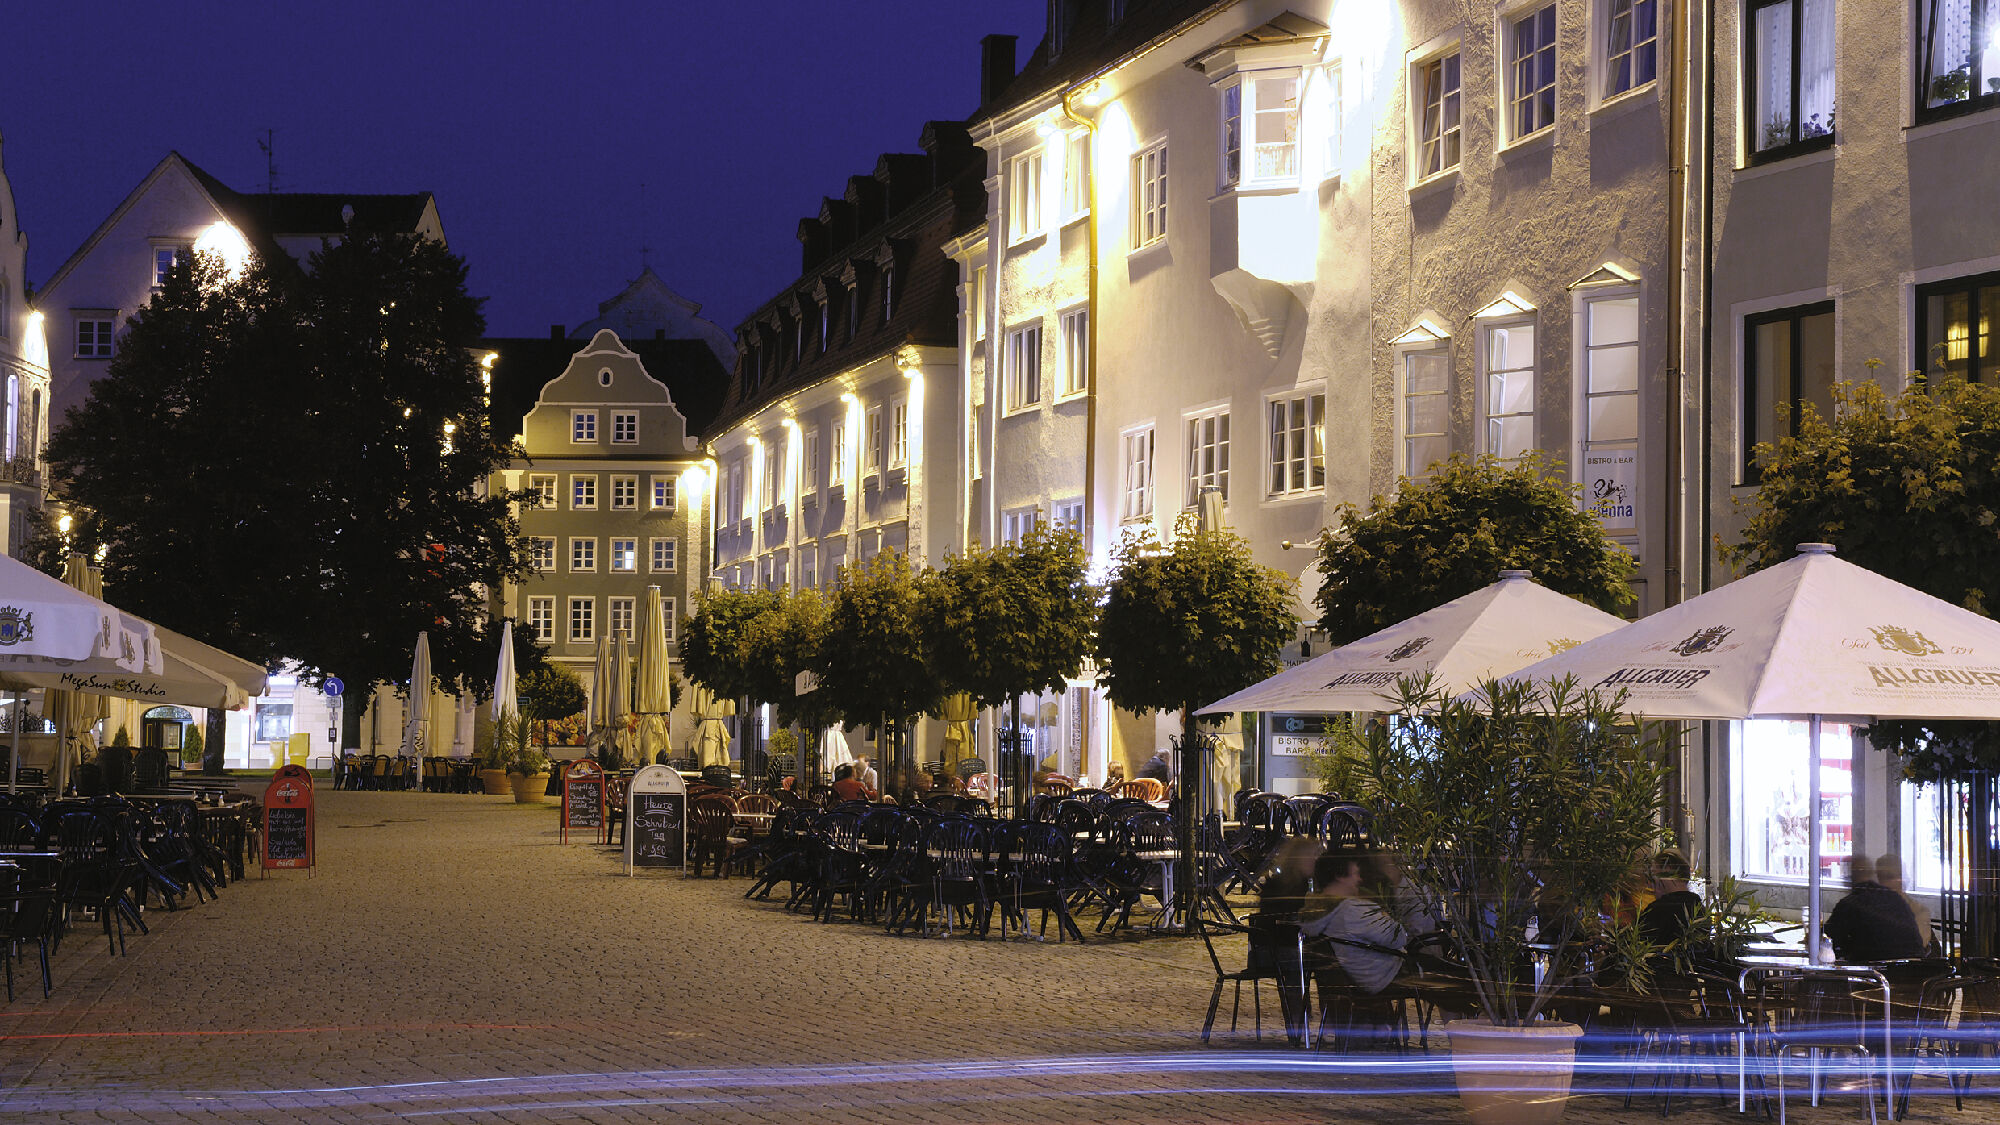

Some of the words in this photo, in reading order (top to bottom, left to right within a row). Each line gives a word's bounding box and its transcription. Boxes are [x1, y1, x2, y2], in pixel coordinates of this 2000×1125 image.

[1587, 457, 1612, 465] BISTRO
[126, 679, 168, 697] Studio
[1278, 737, 1310, 746] BISTRO
[644, 795, 673, 810] Heute
[634, 815, 680, 830] Schnitzel
